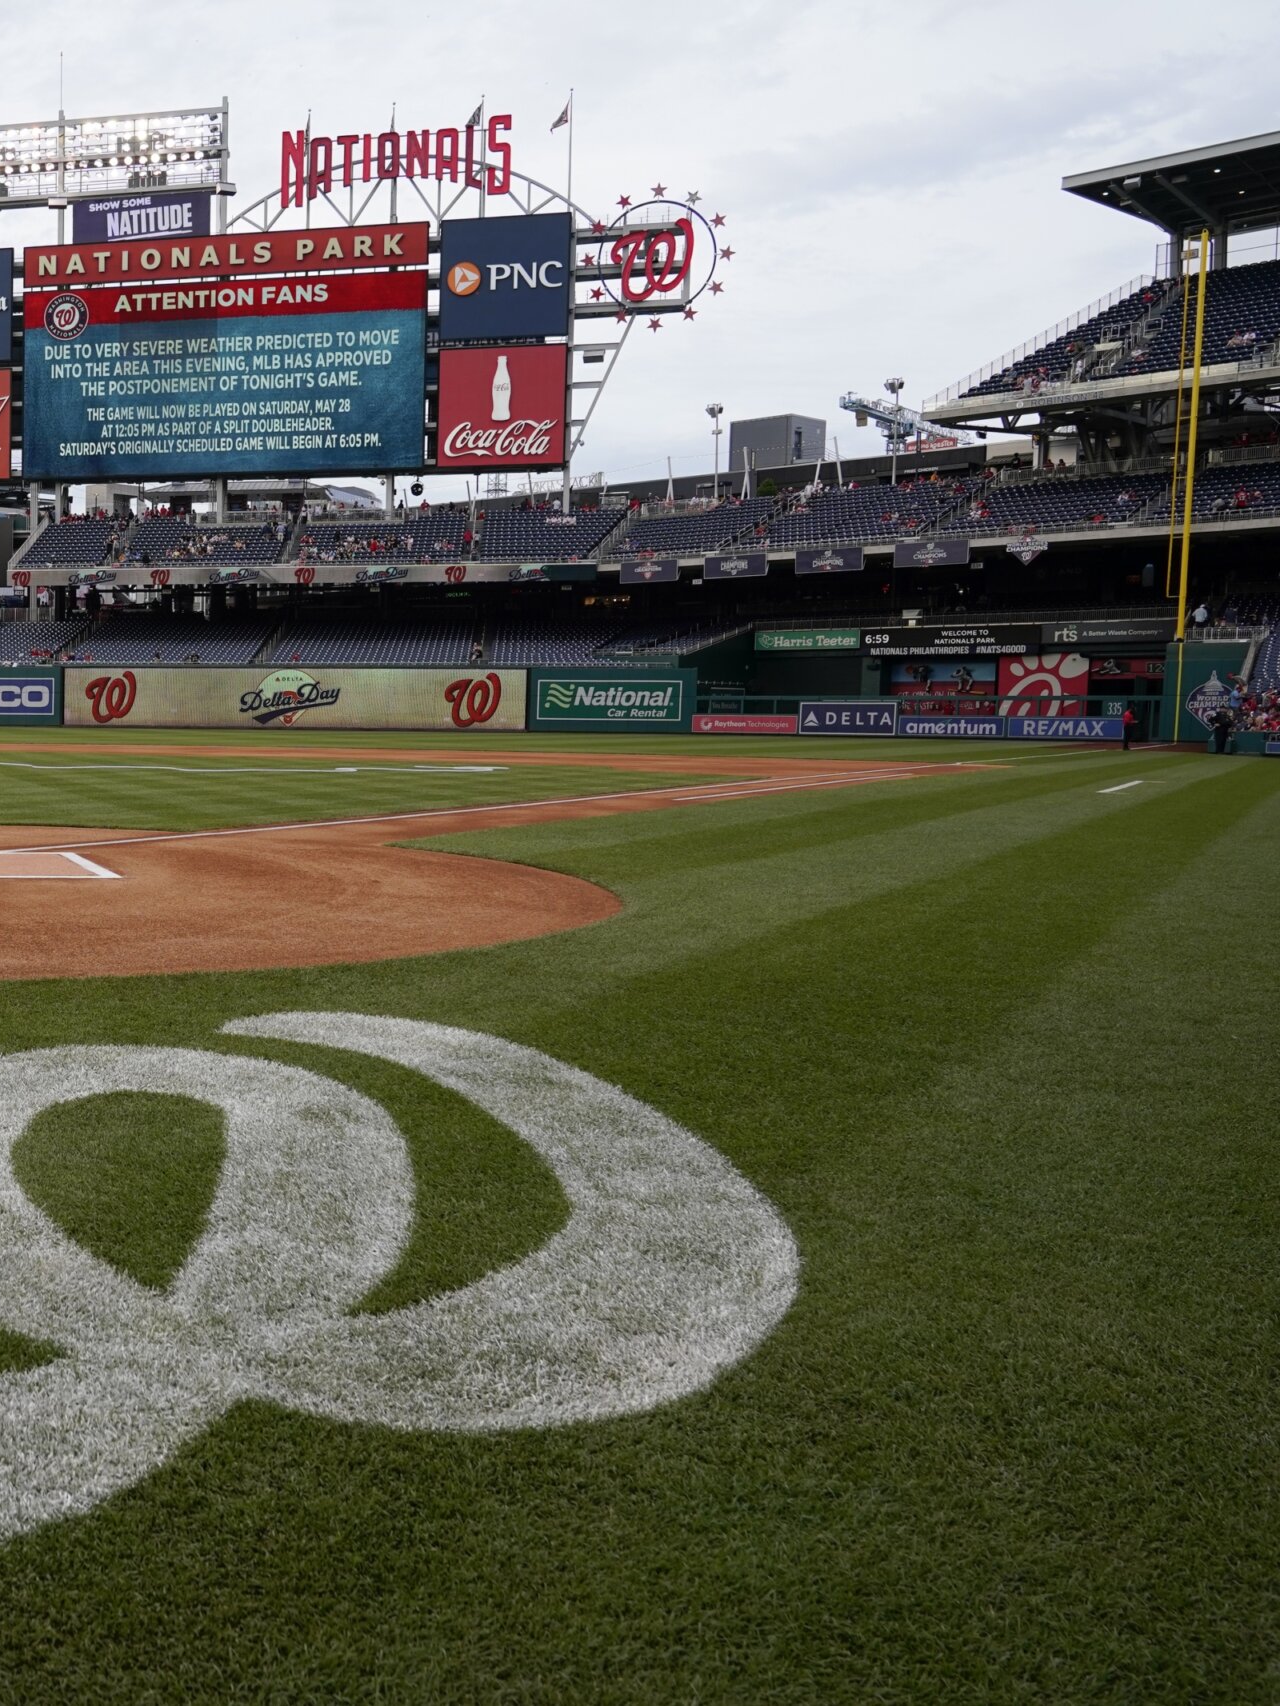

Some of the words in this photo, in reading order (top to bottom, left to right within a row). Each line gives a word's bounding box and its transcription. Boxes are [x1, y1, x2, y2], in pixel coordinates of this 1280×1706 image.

[281, 114, 512, 208] NATIONALS
[89, 201, 120, 212] SHOW
[122, 197, 151, 208] SOME
[107, 202, 193, 237] NATITUDE
[38, 241, 271, 276] NATIONALS
[296, 233, 404, 261] PARK
[486, 260, 563, 290] PNC
[48, 294, 85, 314] WASHINGTON
[114, 287, 254, 312] ATTENTION
[261, 284, 328, 305] FANS
[49, 323, 85, 338] NATIONALS
[45, 345, 70, 361] DUE
[74, 344, 92, 359] TO
[95, 342, 129, 358] VERY
[132, 340, 183, 356] SEVERE
[187, 336, 252, 354] WEATHER
[256, 332, 332, 351] PREDICTED
[336, 331, 355, 346] TO
[359, 329, 400, 346] MOVE
[51, 363, 82, 379] INTO
[85, 362, 110, 377] THE
[114, 359, 149, 376] AREA
[153, 358, 182, 375] THIS
[185, 356, 249, 374] EVENING,
[253, 354, 281, 370] MLB
[284, 353, 312, 369] HAS
[316, 350, 391, 368] APPROVED
[80, 381, 105, 397] THE
[109, 377, 216, 395] POSTPONEMENT
[220, 376, 238, 391] OF
[241, 373, 314, 390] TONIGHT'S
[318, 371, 362, 387] GAME.
[87, 408, 105, 421] THE
[107, 407, 134, 421] GAME
[136, 406, 160, 420] WILL
[162, 405, 186, 418] NOW
[188, 404, 200, 417] BE
[202, 403, 239, 417] PLAYED
[242, 402, 257, 416] ON
[259, 400, 313, 416] SATURDAY,
[315, 399, 336, 413] MAY
[339, 398, 350, 412] 28
[1031, 394, 1088, 407] ROBINSON
[101, 424, 113, 438] AT
[115, 423, 139, 437] 12:05
[141, 423, 154, 437] PM
[157, 422, 170, 436] AS
[172, 422, 196, 435] PART
[199, 421, 211, 435] OF
[214, 420, 221, 434] A
[223, 419, 249, 433] SPLIT
[252, 417, 334, 432] DOUBLEHEADER.
[59, 441, 116, 456] SATURDAY'S
[118, 439, 174, 455] ORIGINALLY
[176, 438, 233, 453] SCHEDULED
[235, 437, 263, 450] GAME
[266, 436, 290, 450] WILL
[292, 435, 321, 449] BEGIN
[325, 434, 337, 448] AT
[339, 433, 361, 448] 6:05
[364, 432, 382, 447] PM.
[444, 419, 558, 457] Coca-Cola
[96, 570, 117, 582] Day
[387, 567, 408, 579] Day
[774, 636, 812, 647] Harris
[816, 635, 856, 646] Teeter
[865, 634, 889, 644] 6:59
[1054, 630, 1077, 642] rts
[870, 647, 908, 655] NATIONALS
[910, 646, 969, 655] PHILANTHROPIES
[976, 645, 1026, 654] #NATS4GOOD
[240, 689, 293, 712] Delta
[297, 681, 340, 704] Day
[574, 686, 672, 706] National
[607, 708, 627, 718] Car
[630, 708, 667, 718] Rental
[825, 711, 892, 726] DELTA
[1107, 703, 1122, 715] 335
[714, 720, 746, 728] Raytheon
[747, 720, 789, 729] Technologies
[906, 719, 996, 735] amentum
[1023, 720, 1104, 736] RE/MAX
